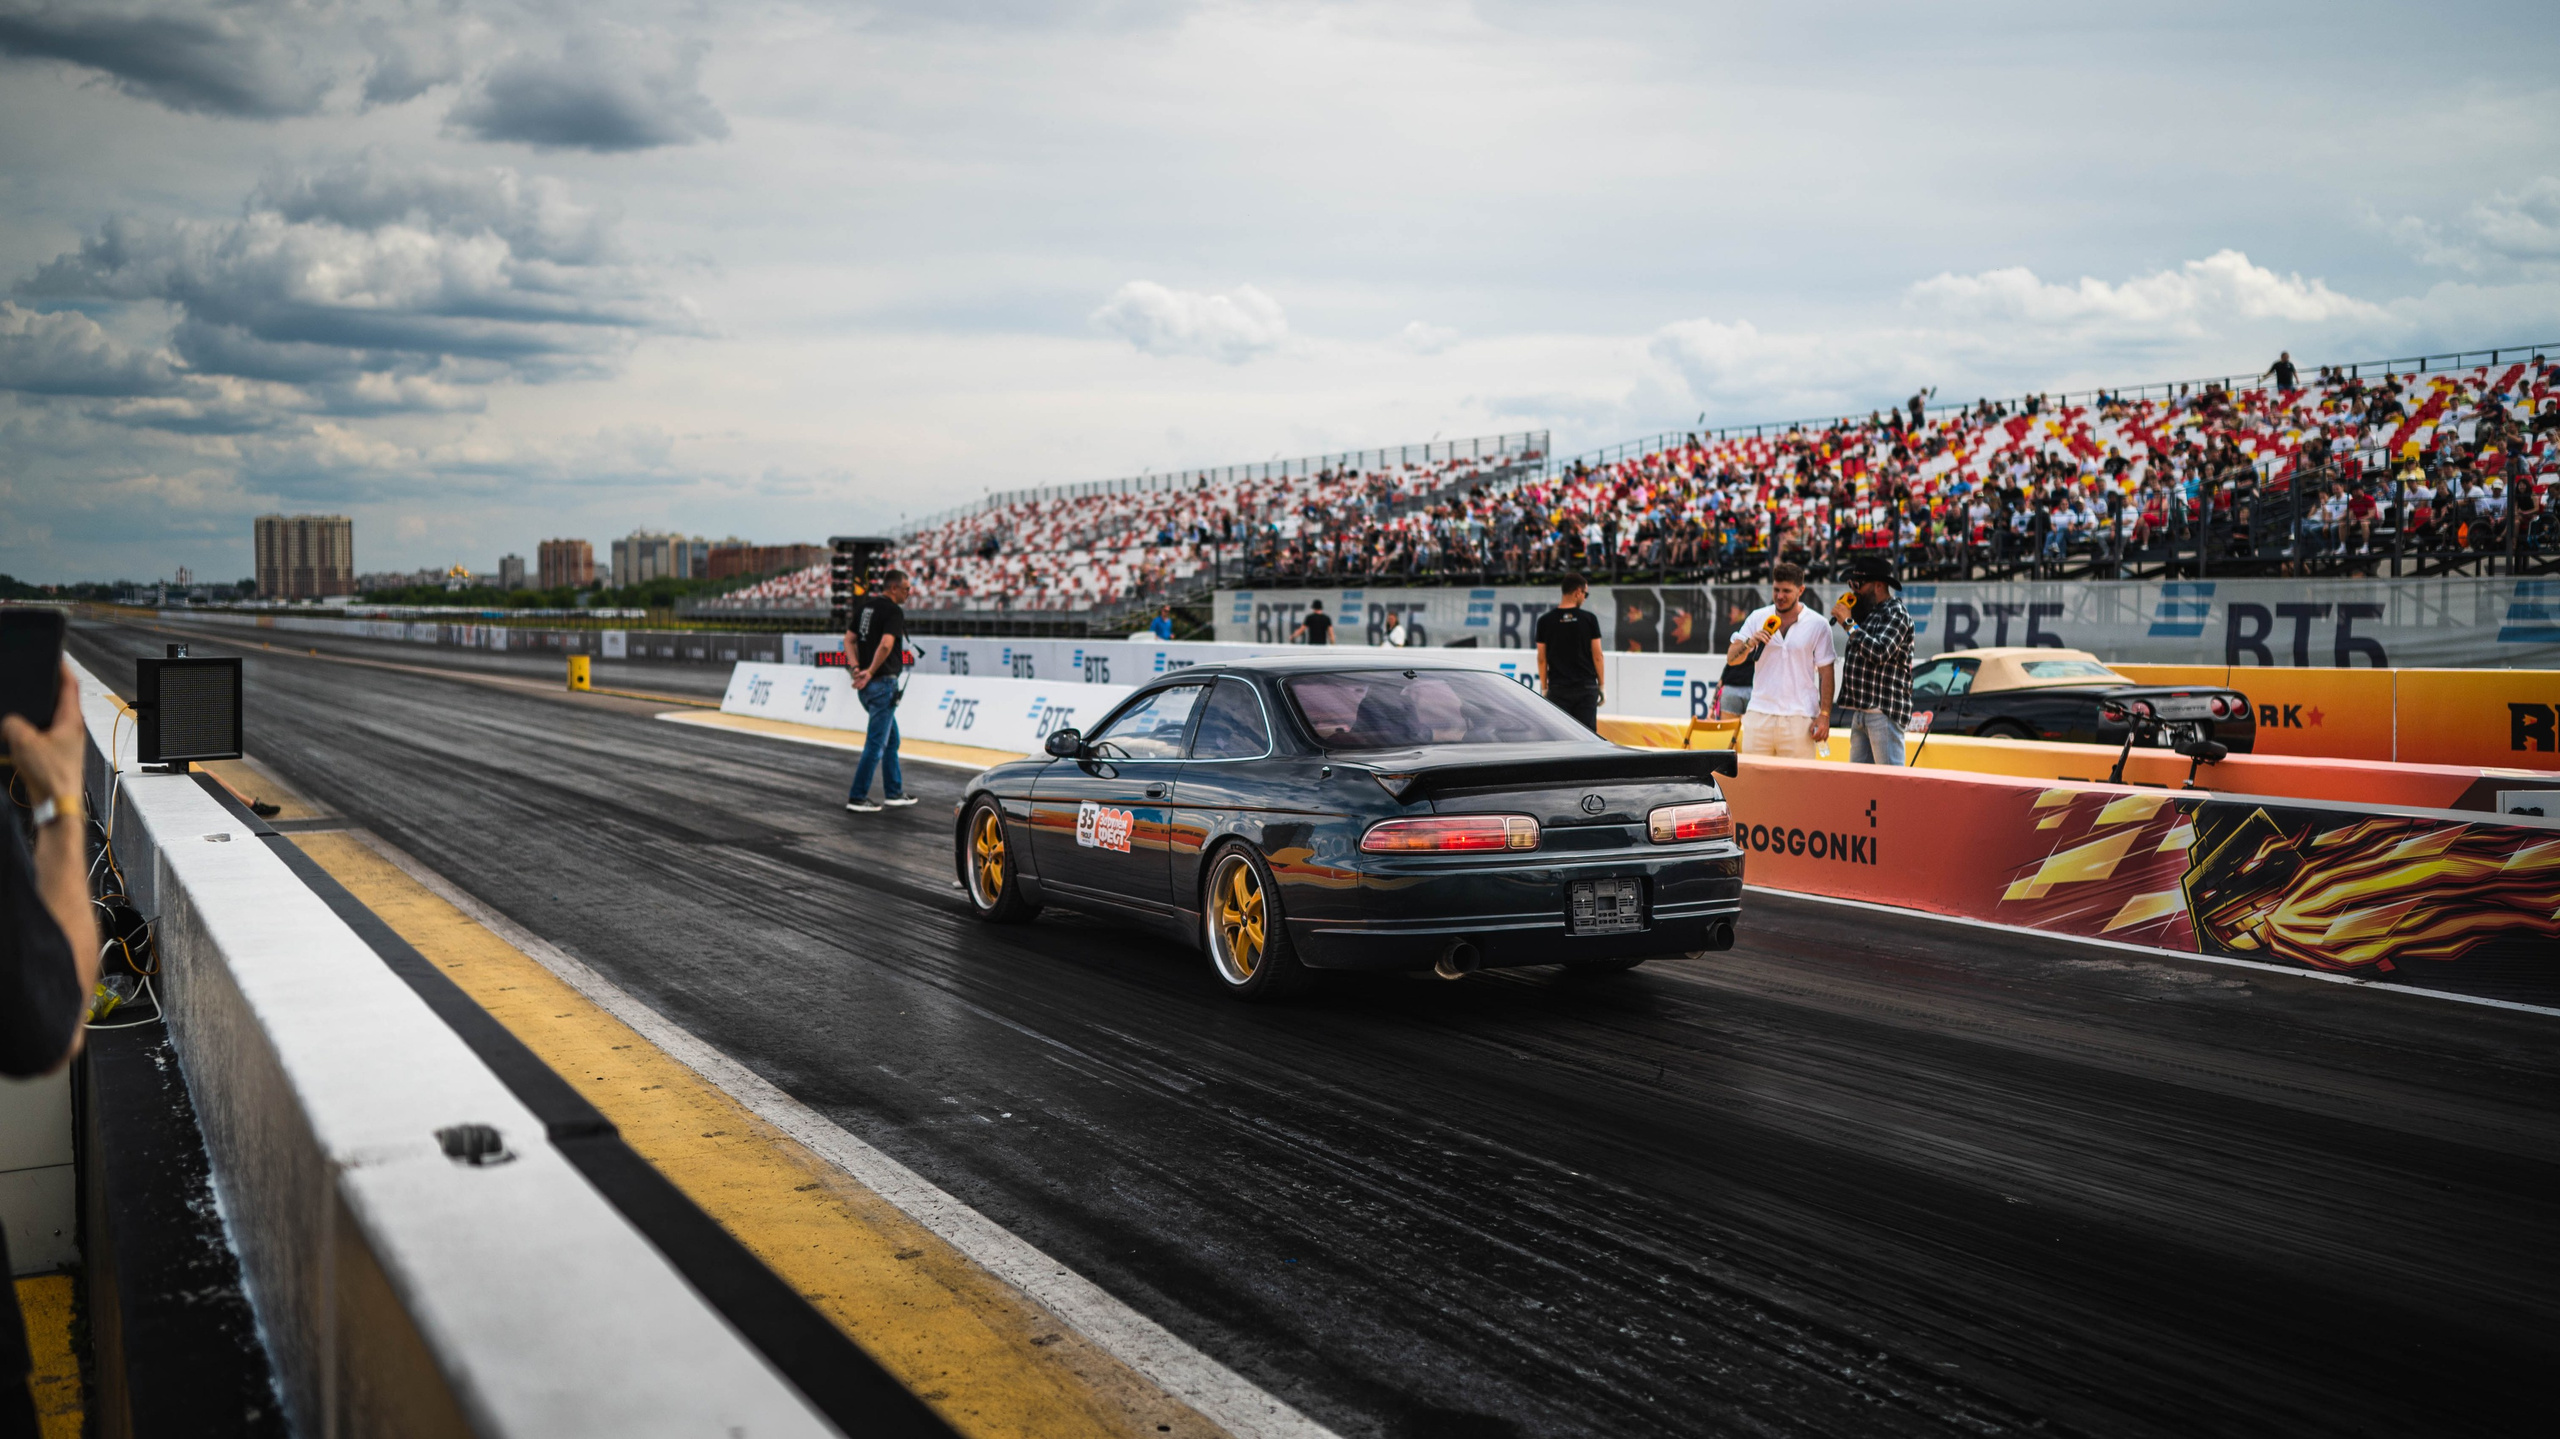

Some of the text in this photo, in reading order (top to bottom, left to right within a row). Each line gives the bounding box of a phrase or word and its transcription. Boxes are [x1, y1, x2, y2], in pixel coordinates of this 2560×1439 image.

[1943, 602, 2066, 652] ВТБ
[2225, 602, 2389, 668] ВТБ
[950, 651, 970, 675] ВТБ
[1012, 654, 1034, 679] ВТБ
[1084, 656, 1111, 684] ВТБ
[749, 681, 773, 706] ВТБ
[804, 685, 830, 712] ВТБ
[945, 698, 979, 730] ВТБ
[1036, 706, 1076, 739] ВТБ
[1080, 807, 1096, 830] 35
[1098, 827, 1127, 847] ФЕСТ
[1735, 822, 1877, 865] ROSGONKI
